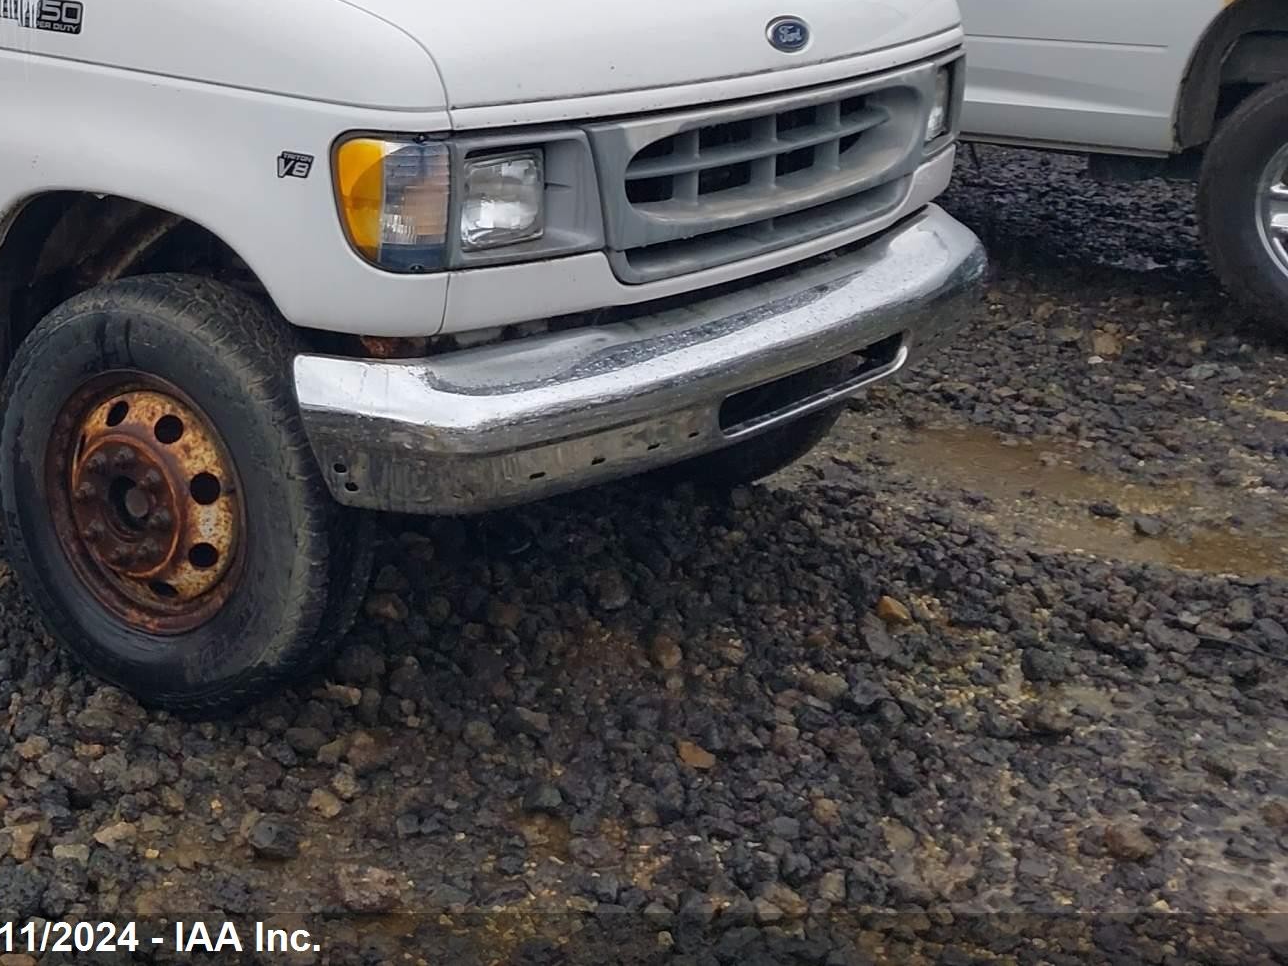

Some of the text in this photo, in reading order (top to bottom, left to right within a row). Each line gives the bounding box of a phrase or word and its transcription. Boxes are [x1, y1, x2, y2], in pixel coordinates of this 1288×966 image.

[52, 23, 78, 32] DUTY
[778, 25, 802, 43] Ford
[278, 157, 309, 177] V8
